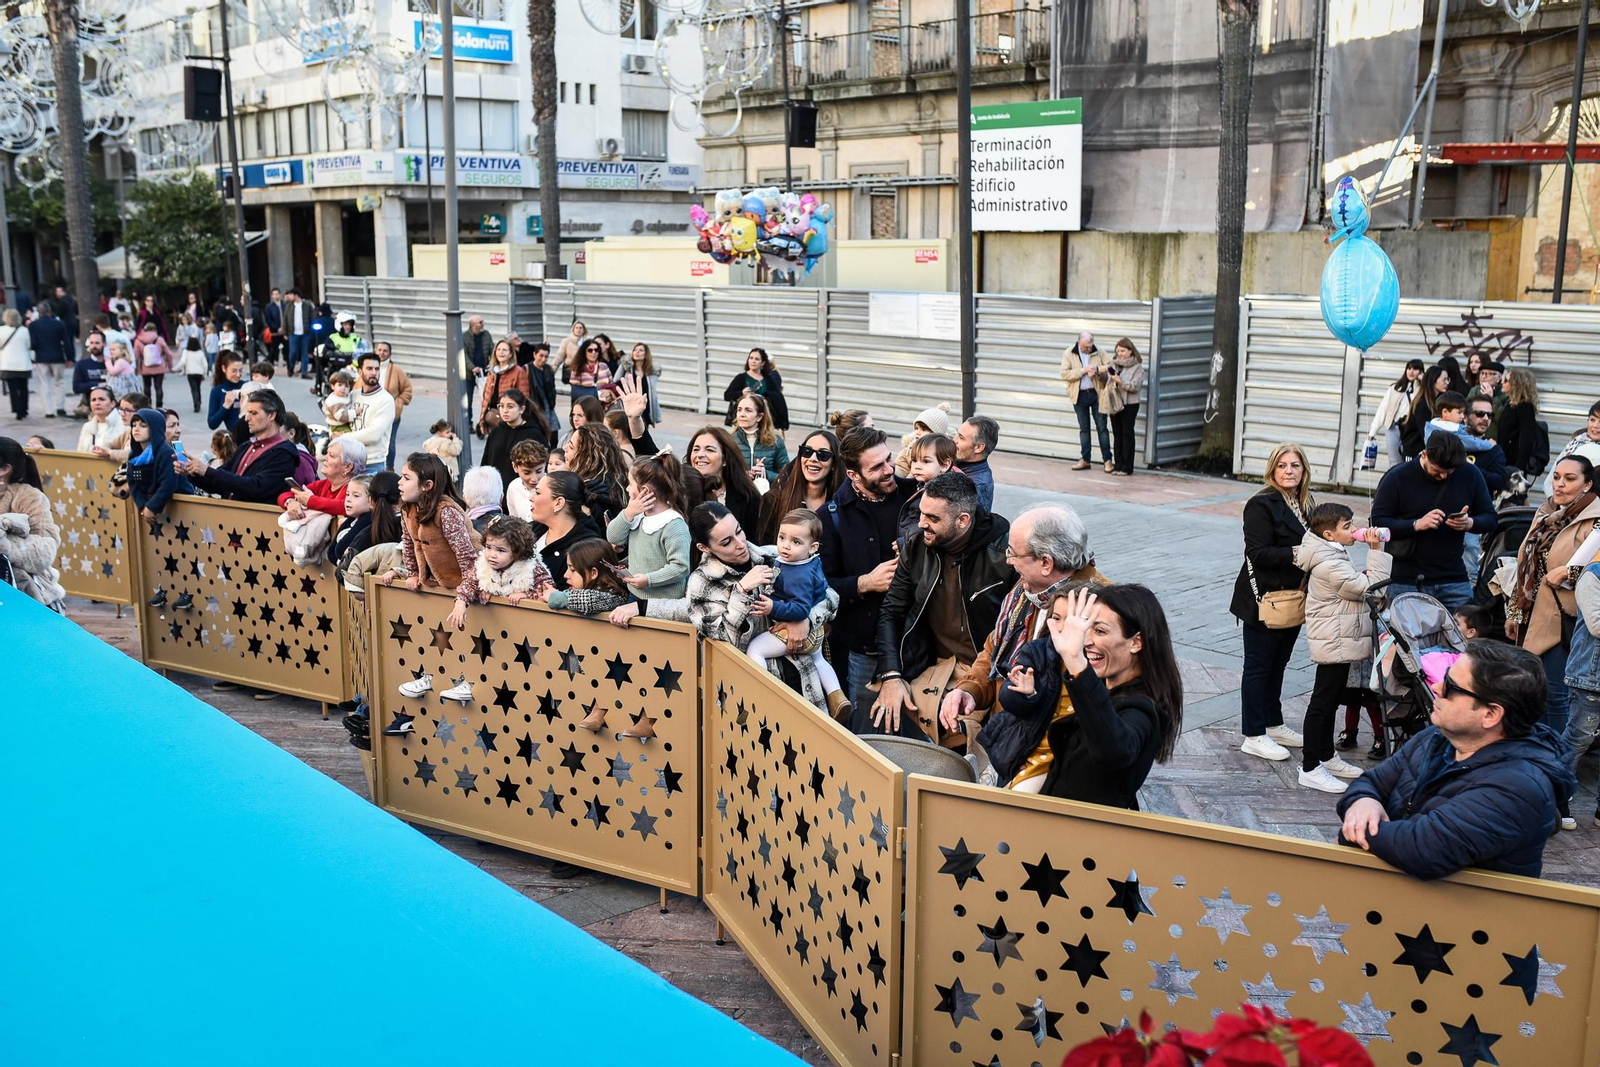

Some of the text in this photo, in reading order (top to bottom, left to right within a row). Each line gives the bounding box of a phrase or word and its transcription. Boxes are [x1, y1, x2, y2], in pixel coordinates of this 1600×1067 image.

[971, 135, 1052, 152] Terminación
[316, 155, 362, 170] PREVENTIVA
[971, 155, 1065, 172] Rehabilitación
[464, 173, 522, 185] SEGUROS
[585, 176, 637, 188] SEGUROS
[645, 219, 690, 235] cajamar
